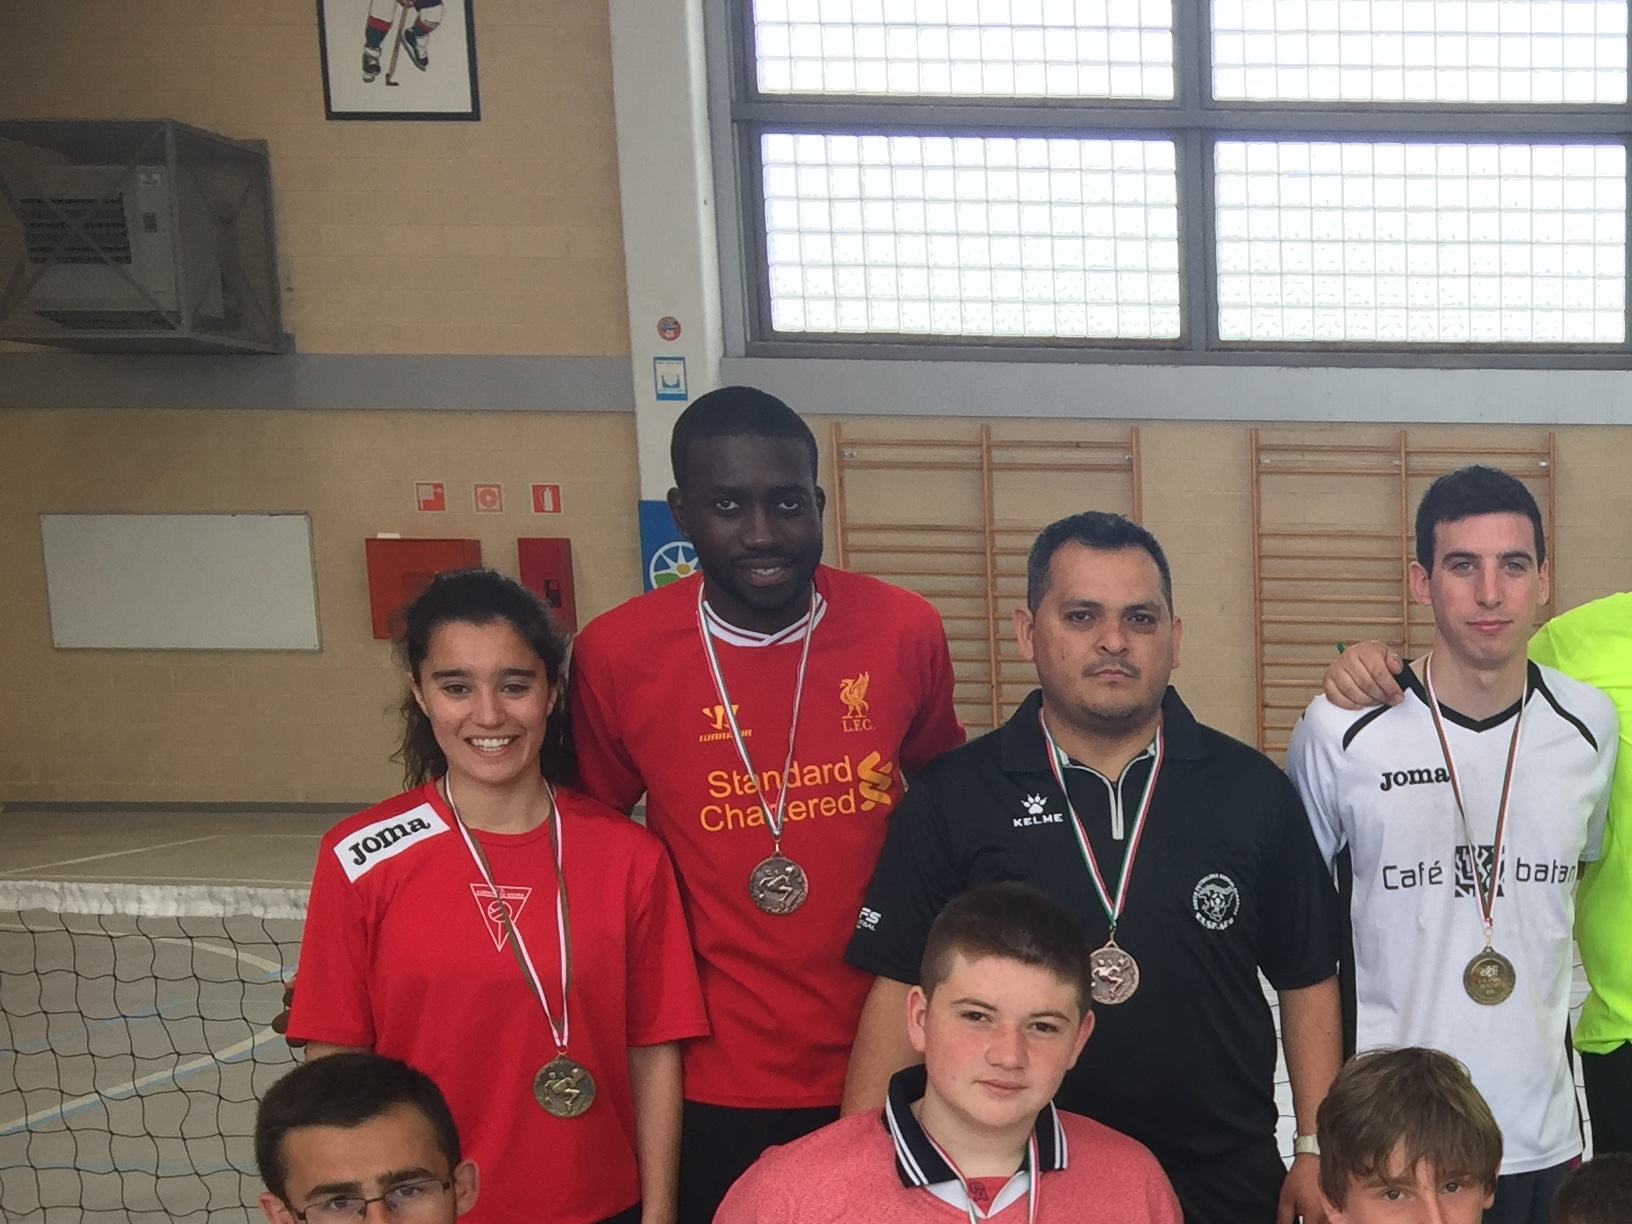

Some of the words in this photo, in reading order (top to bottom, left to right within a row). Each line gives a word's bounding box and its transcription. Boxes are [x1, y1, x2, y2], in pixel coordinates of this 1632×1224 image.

[707, 755, 853, 798] Standard
[1379, 766, 1451, 792] Joma
[700, 788, 856, 832] Chaered
[1012, 812, 1064, 828] KELME
[348, 816, 432, 866] Joma
[1382, 860, 1443, 890] Café
